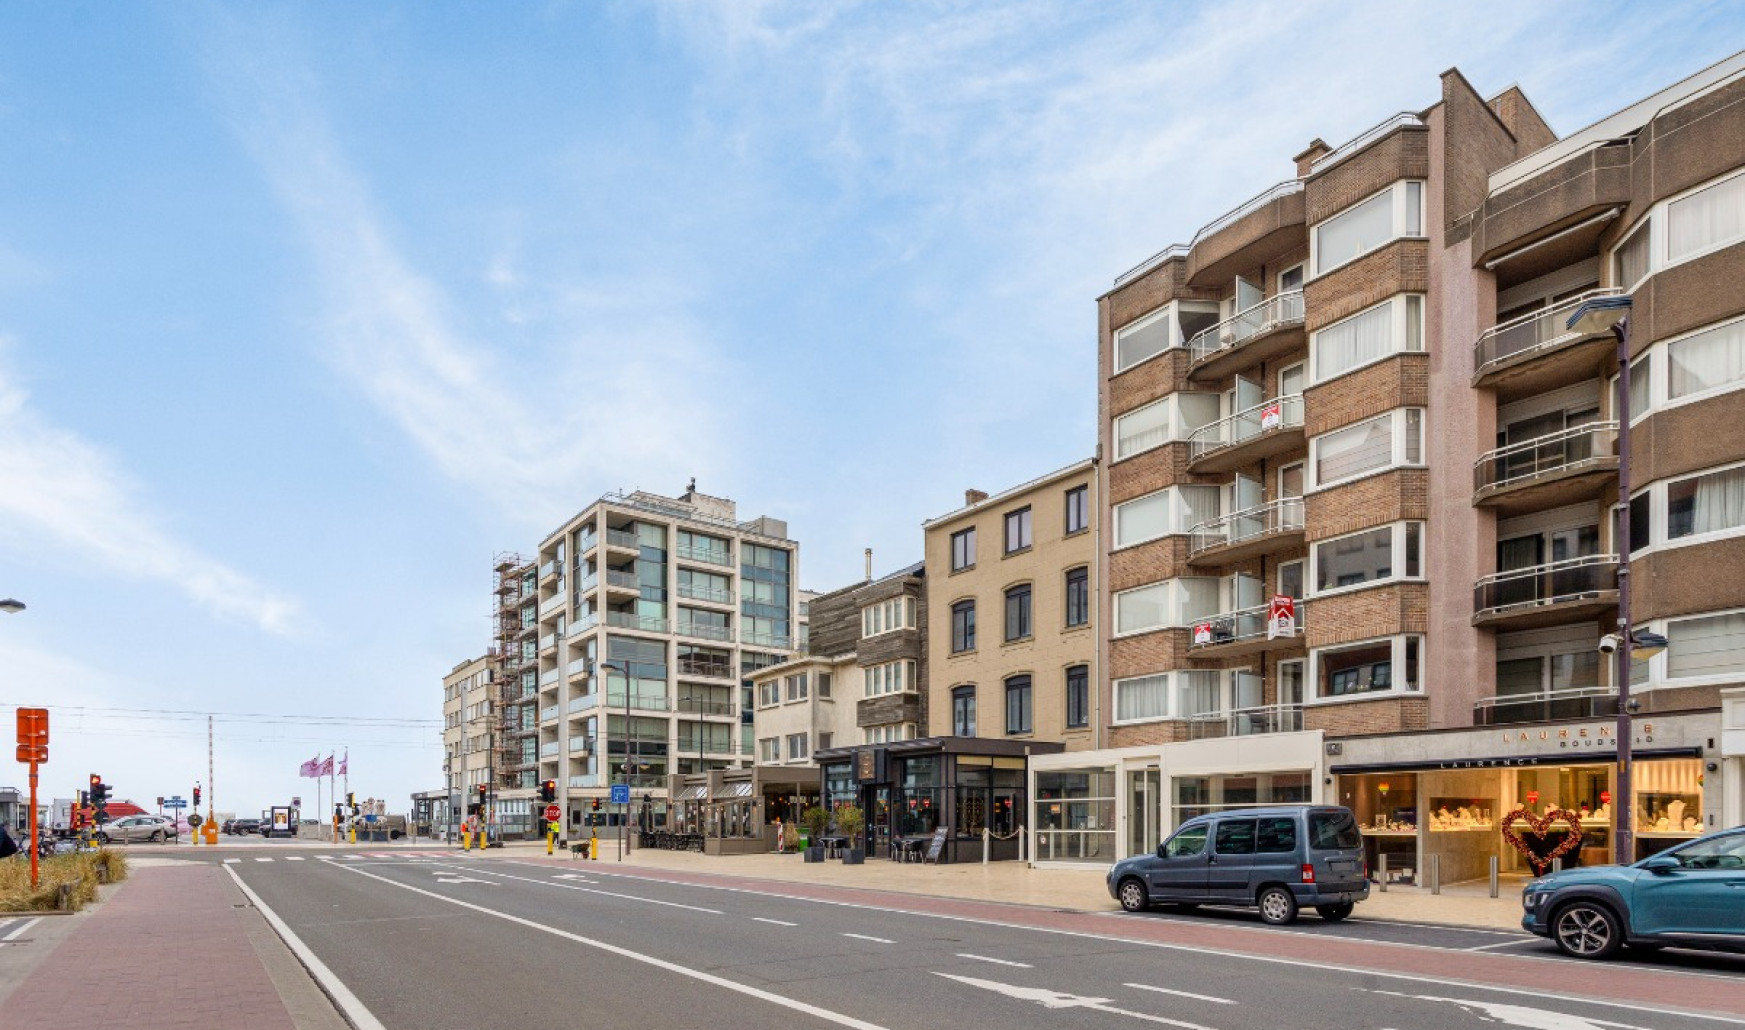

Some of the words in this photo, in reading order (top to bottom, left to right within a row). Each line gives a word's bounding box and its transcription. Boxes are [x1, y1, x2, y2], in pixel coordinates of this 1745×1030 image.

[1503, 723, 1653, 743] LAURENE
[1440, 758, 1538, 769] LAURENCE
[544, 809, 561, 817] STOP
